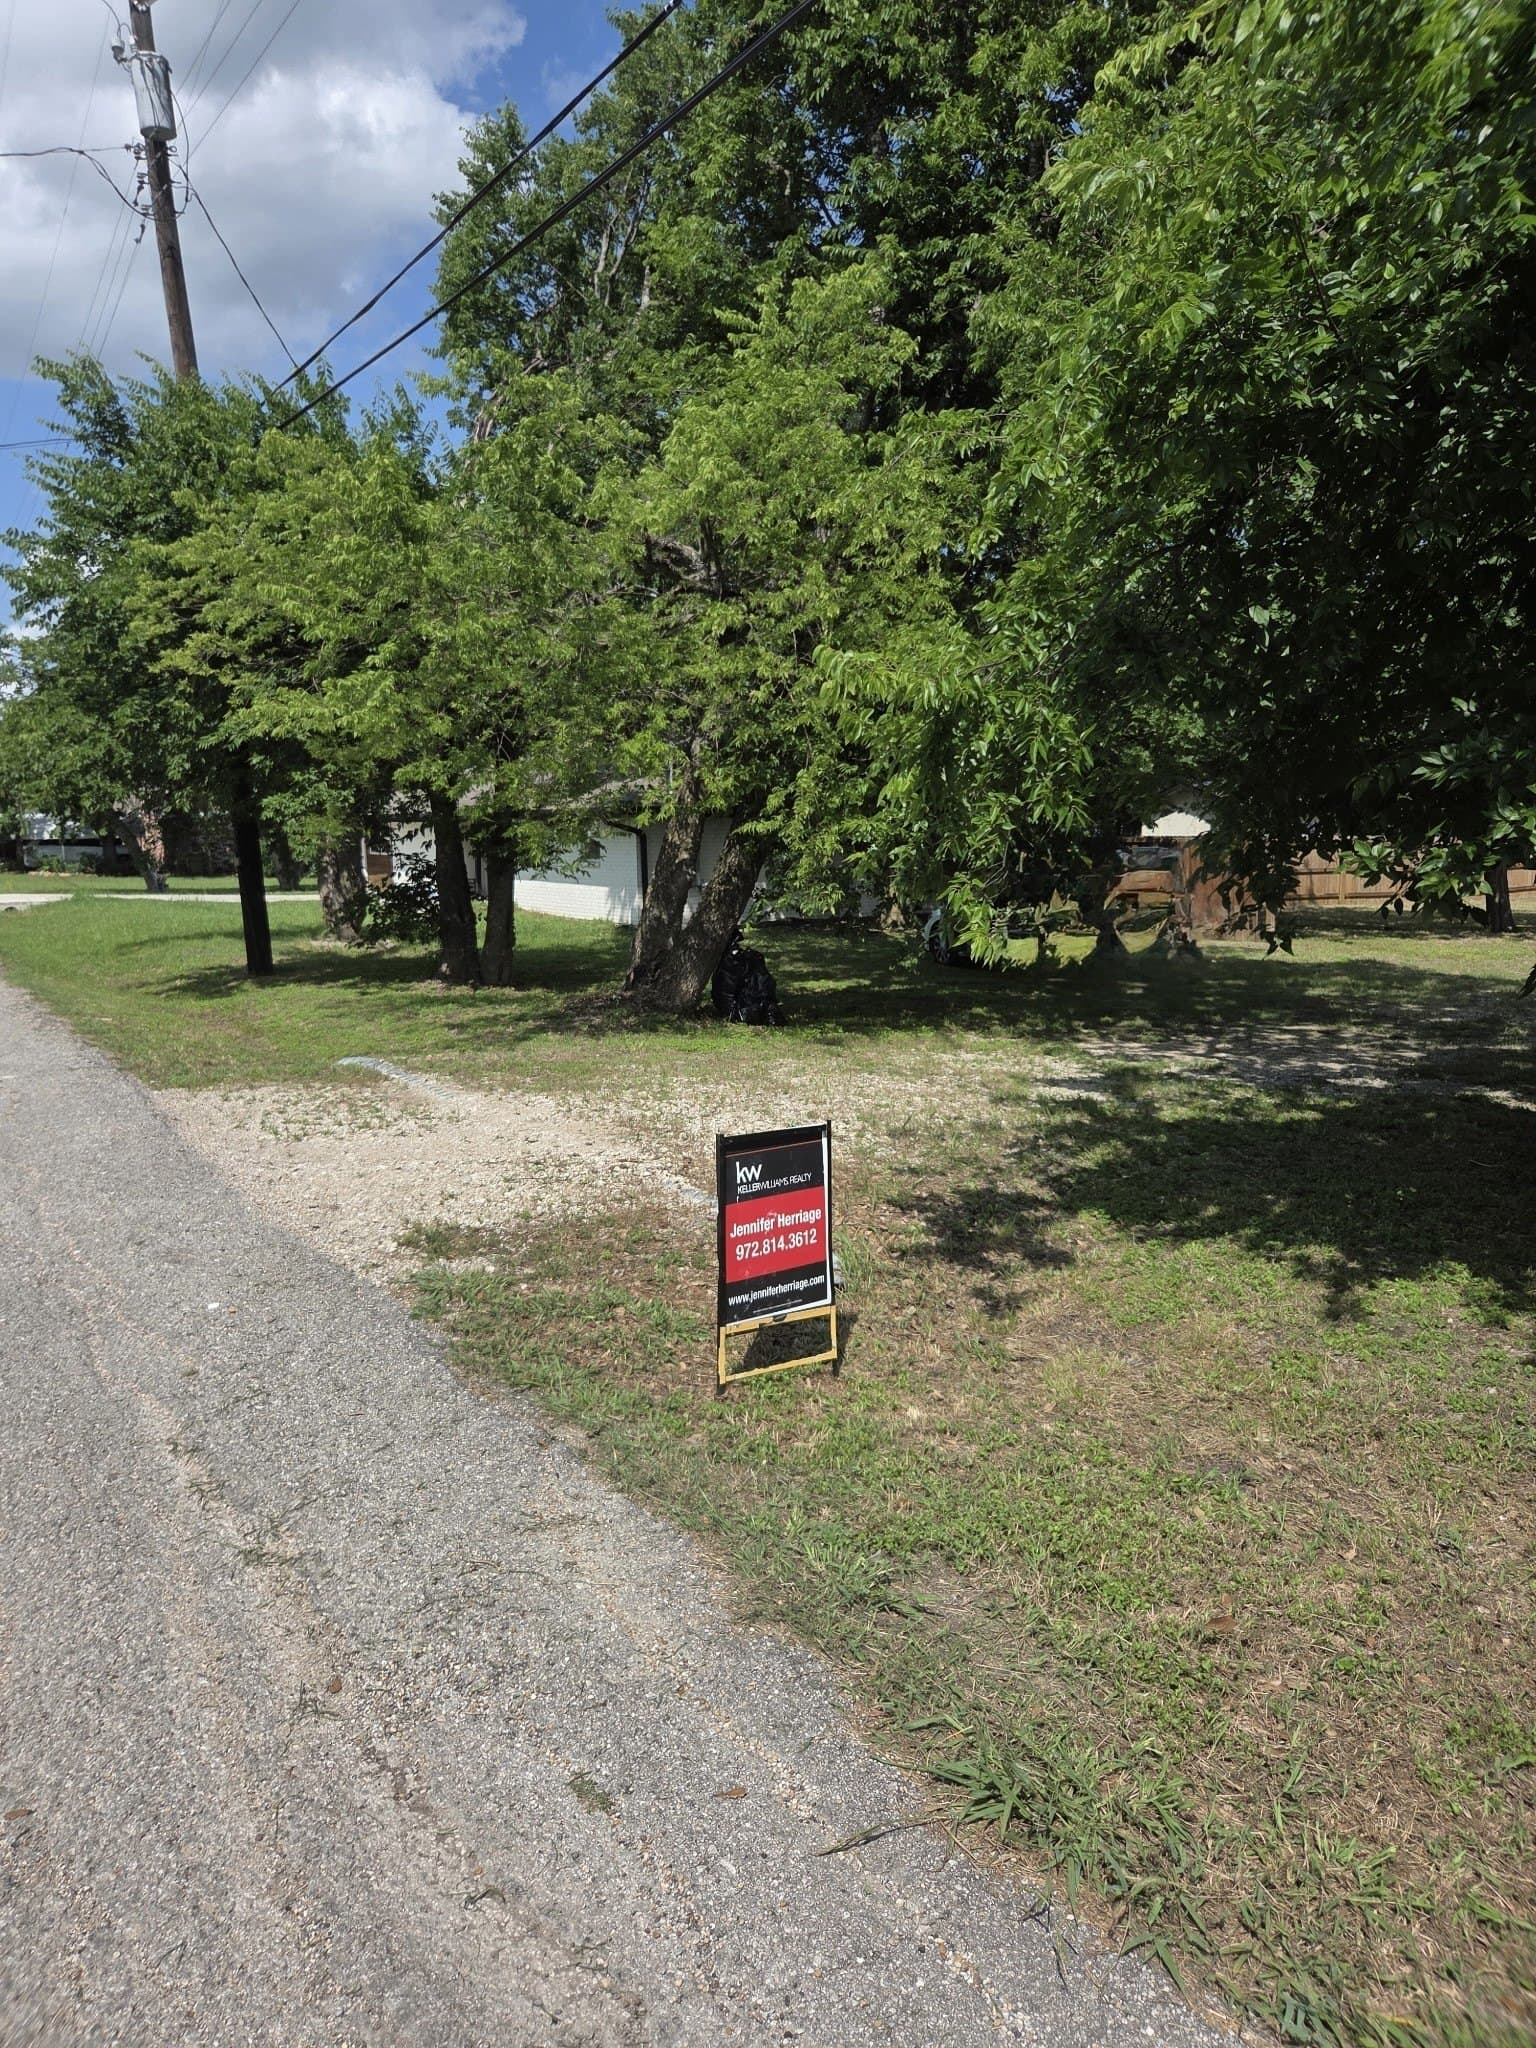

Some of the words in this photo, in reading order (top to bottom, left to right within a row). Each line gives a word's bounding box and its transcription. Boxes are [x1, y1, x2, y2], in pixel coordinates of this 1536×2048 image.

[789, 1172, 812, 1184] REALTY
[729, 1216, 775, 1238] Jennifer
[777, 1208, 822, 1228] Herriage
[735, 1228, 817, 1261] 972.814.3612
[728, 1274, 825, 1306] www.jenniferherriage.com
